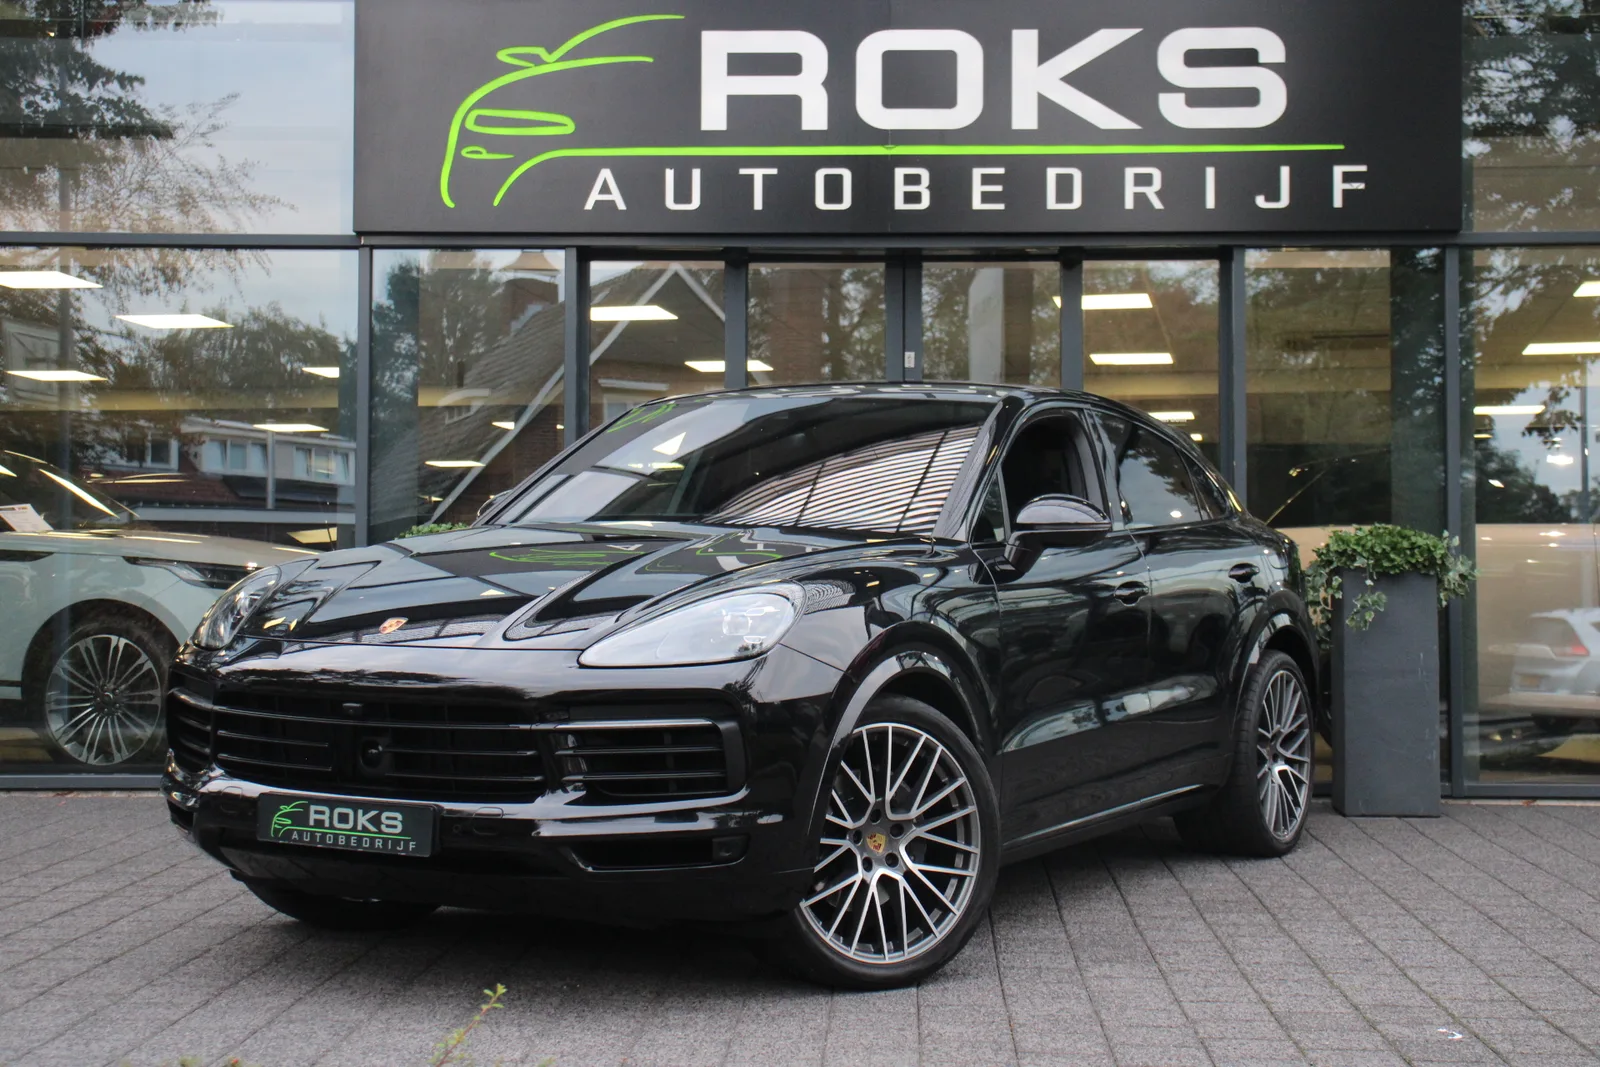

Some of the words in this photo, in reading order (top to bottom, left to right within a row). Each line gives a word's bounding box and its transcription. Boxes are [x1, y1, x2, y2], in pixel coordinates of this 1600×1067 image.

[700, 26, 1288, 132] ROKS
[583, 164, 1368, 212] AUTOBEDRIJF
[309, 804, 403, 833] ROKS
[292, 831, 416, 851] AUTOBEDRIJF
